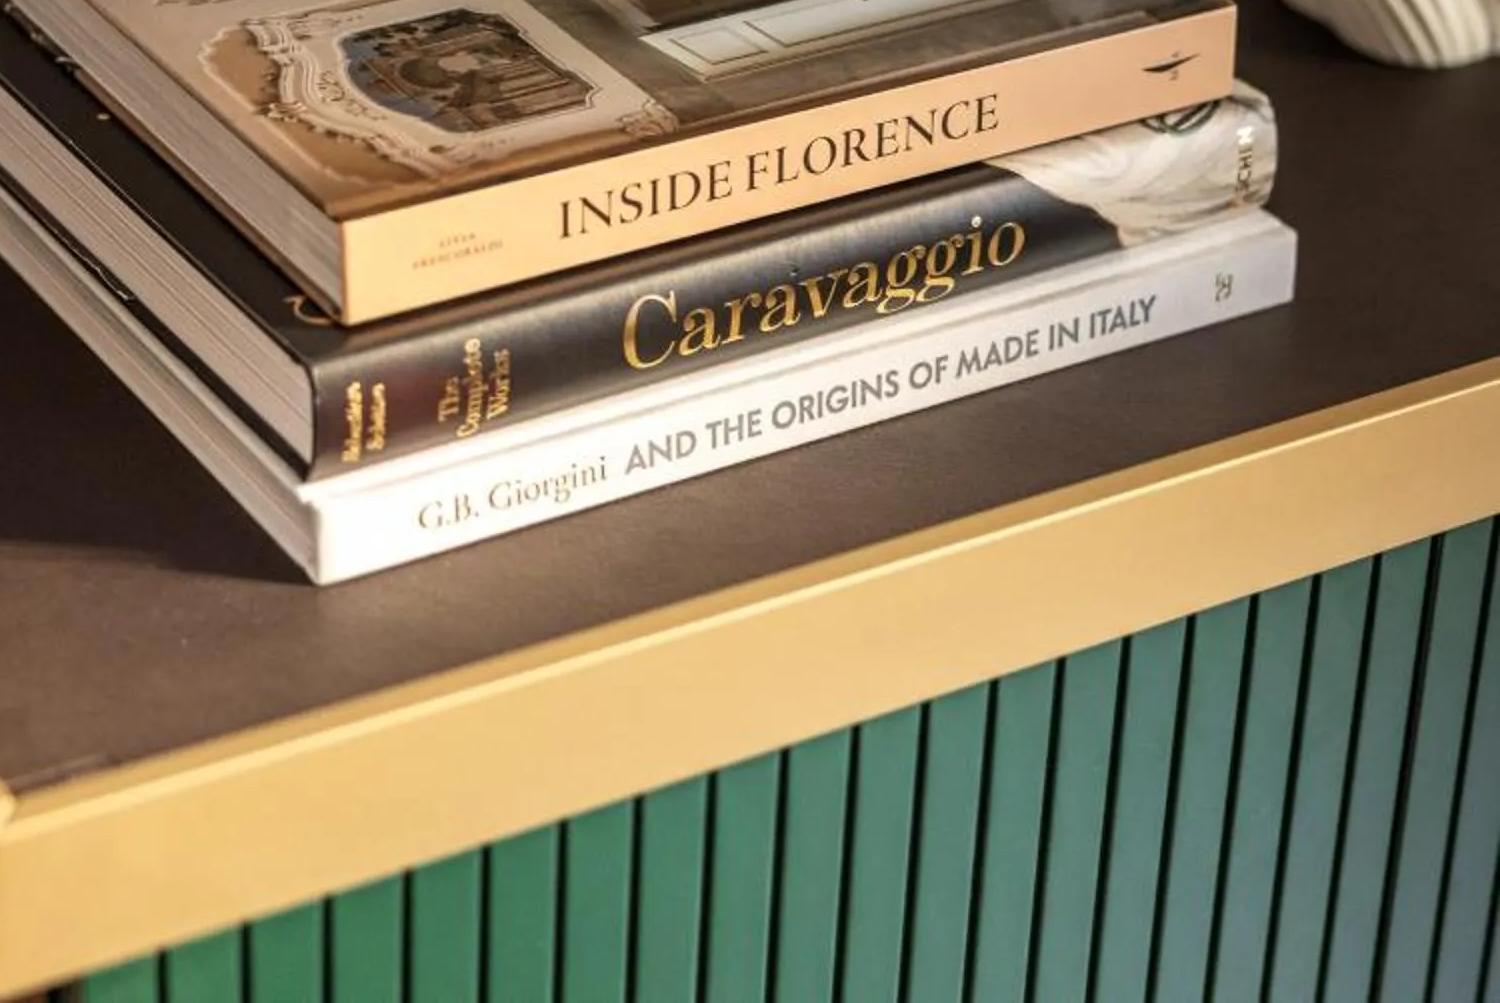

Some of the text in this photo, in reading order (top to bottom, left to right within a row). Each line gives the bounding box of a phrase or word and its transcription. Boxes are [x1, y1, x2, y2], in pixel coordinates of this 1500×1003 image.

[559, 94, 999, 239] INSIDE FLORENCE
[623, 215, 1025, 369] Caravaggio
[418, 296, 1156, 530] G.B. Giorgini AND THE ORIGINS OF MADE IN ITALY
